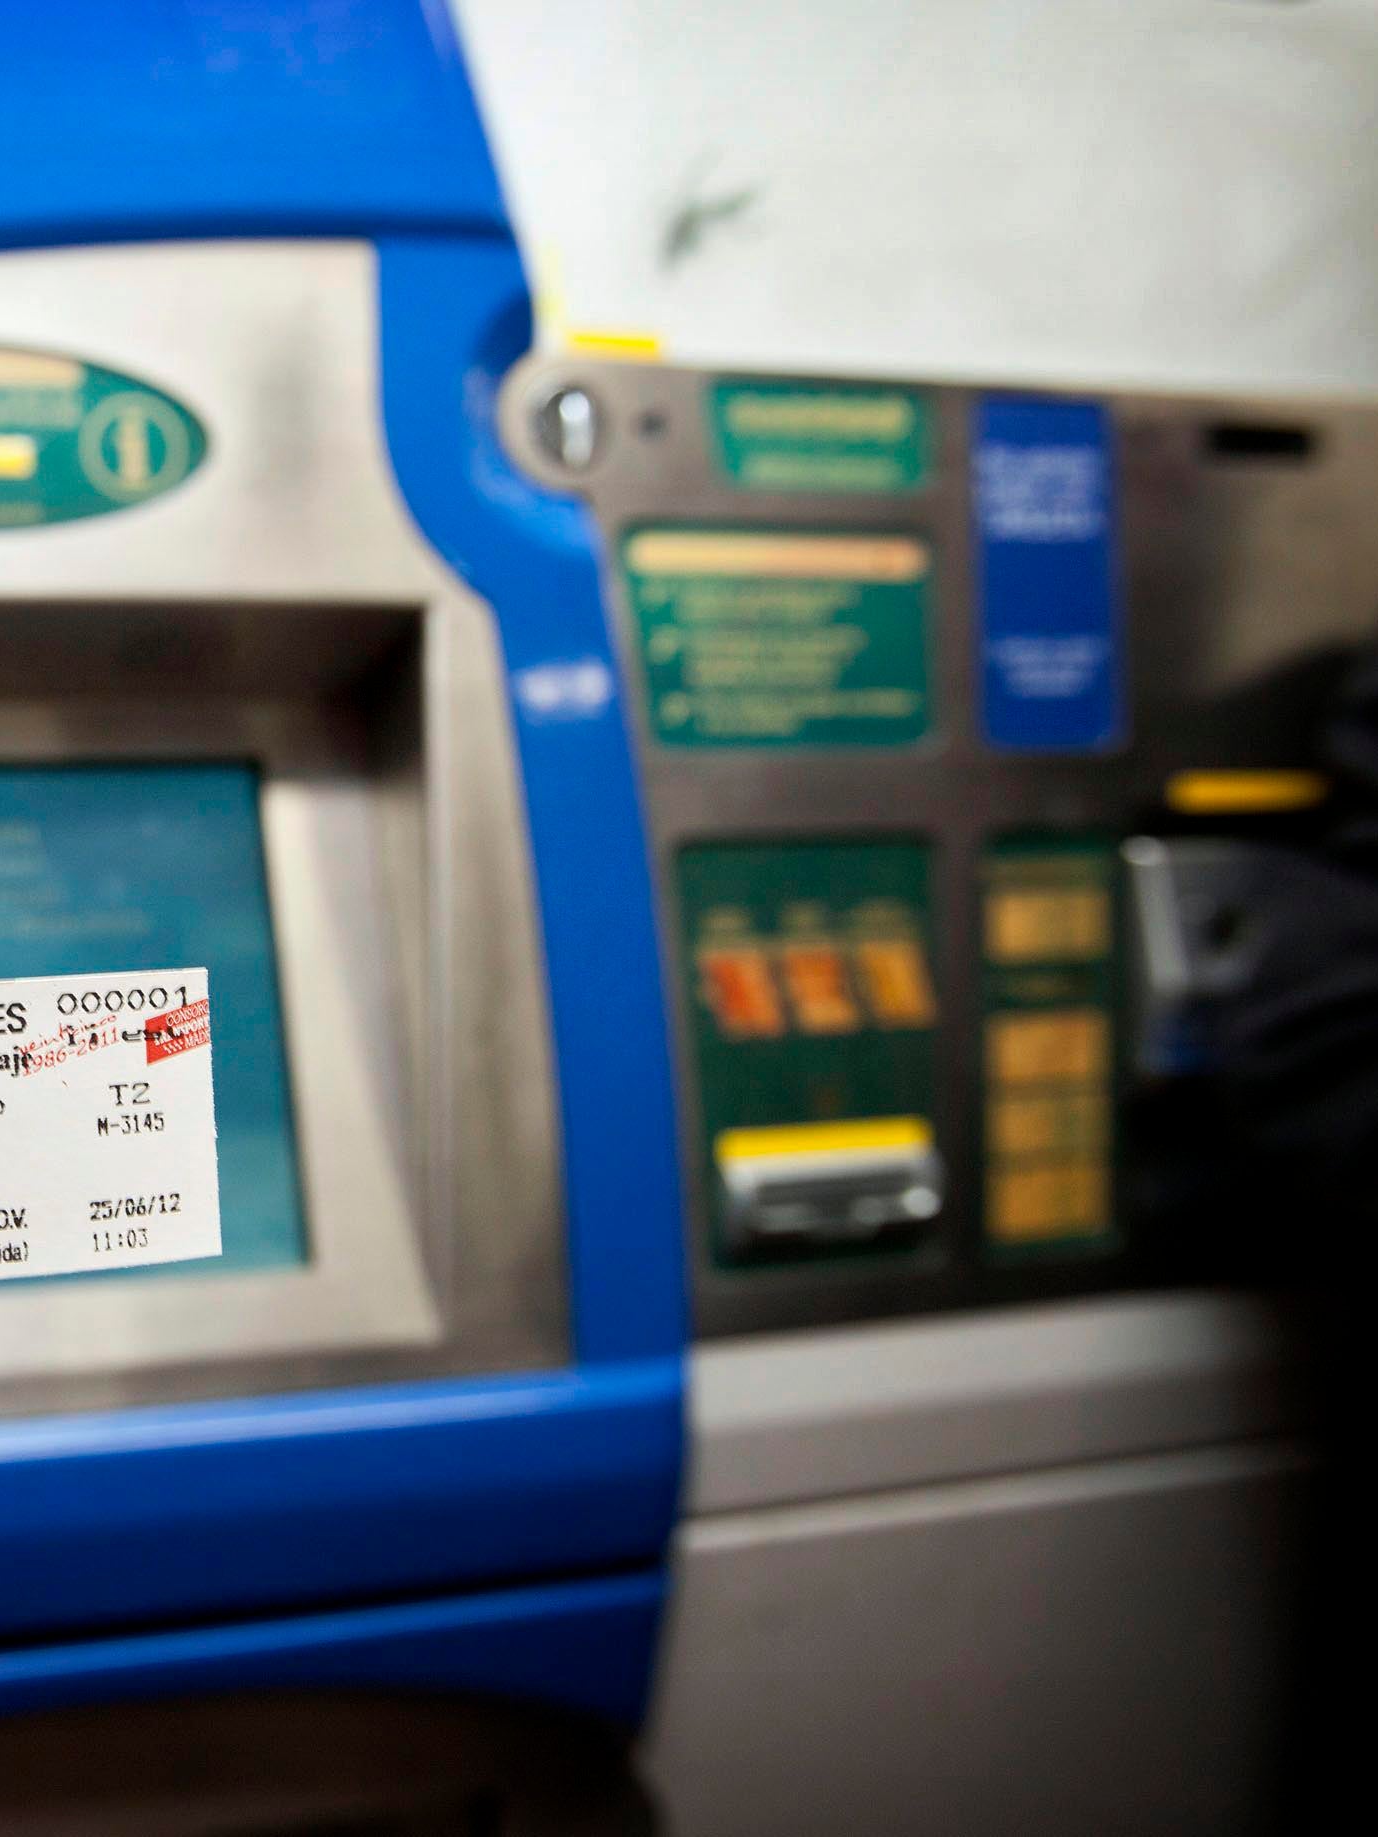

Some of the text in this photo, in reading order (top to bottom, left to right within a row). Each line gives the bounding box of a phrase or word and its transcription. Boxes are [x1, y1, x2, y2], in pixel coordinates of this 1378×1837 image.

[57, 985, 188, 1016] 000001
[109, 1082, 152, 1106] T2
[89, 1192, 182, 1222] 25/06/12
[92, 1227, 149, 1252] 11:03
